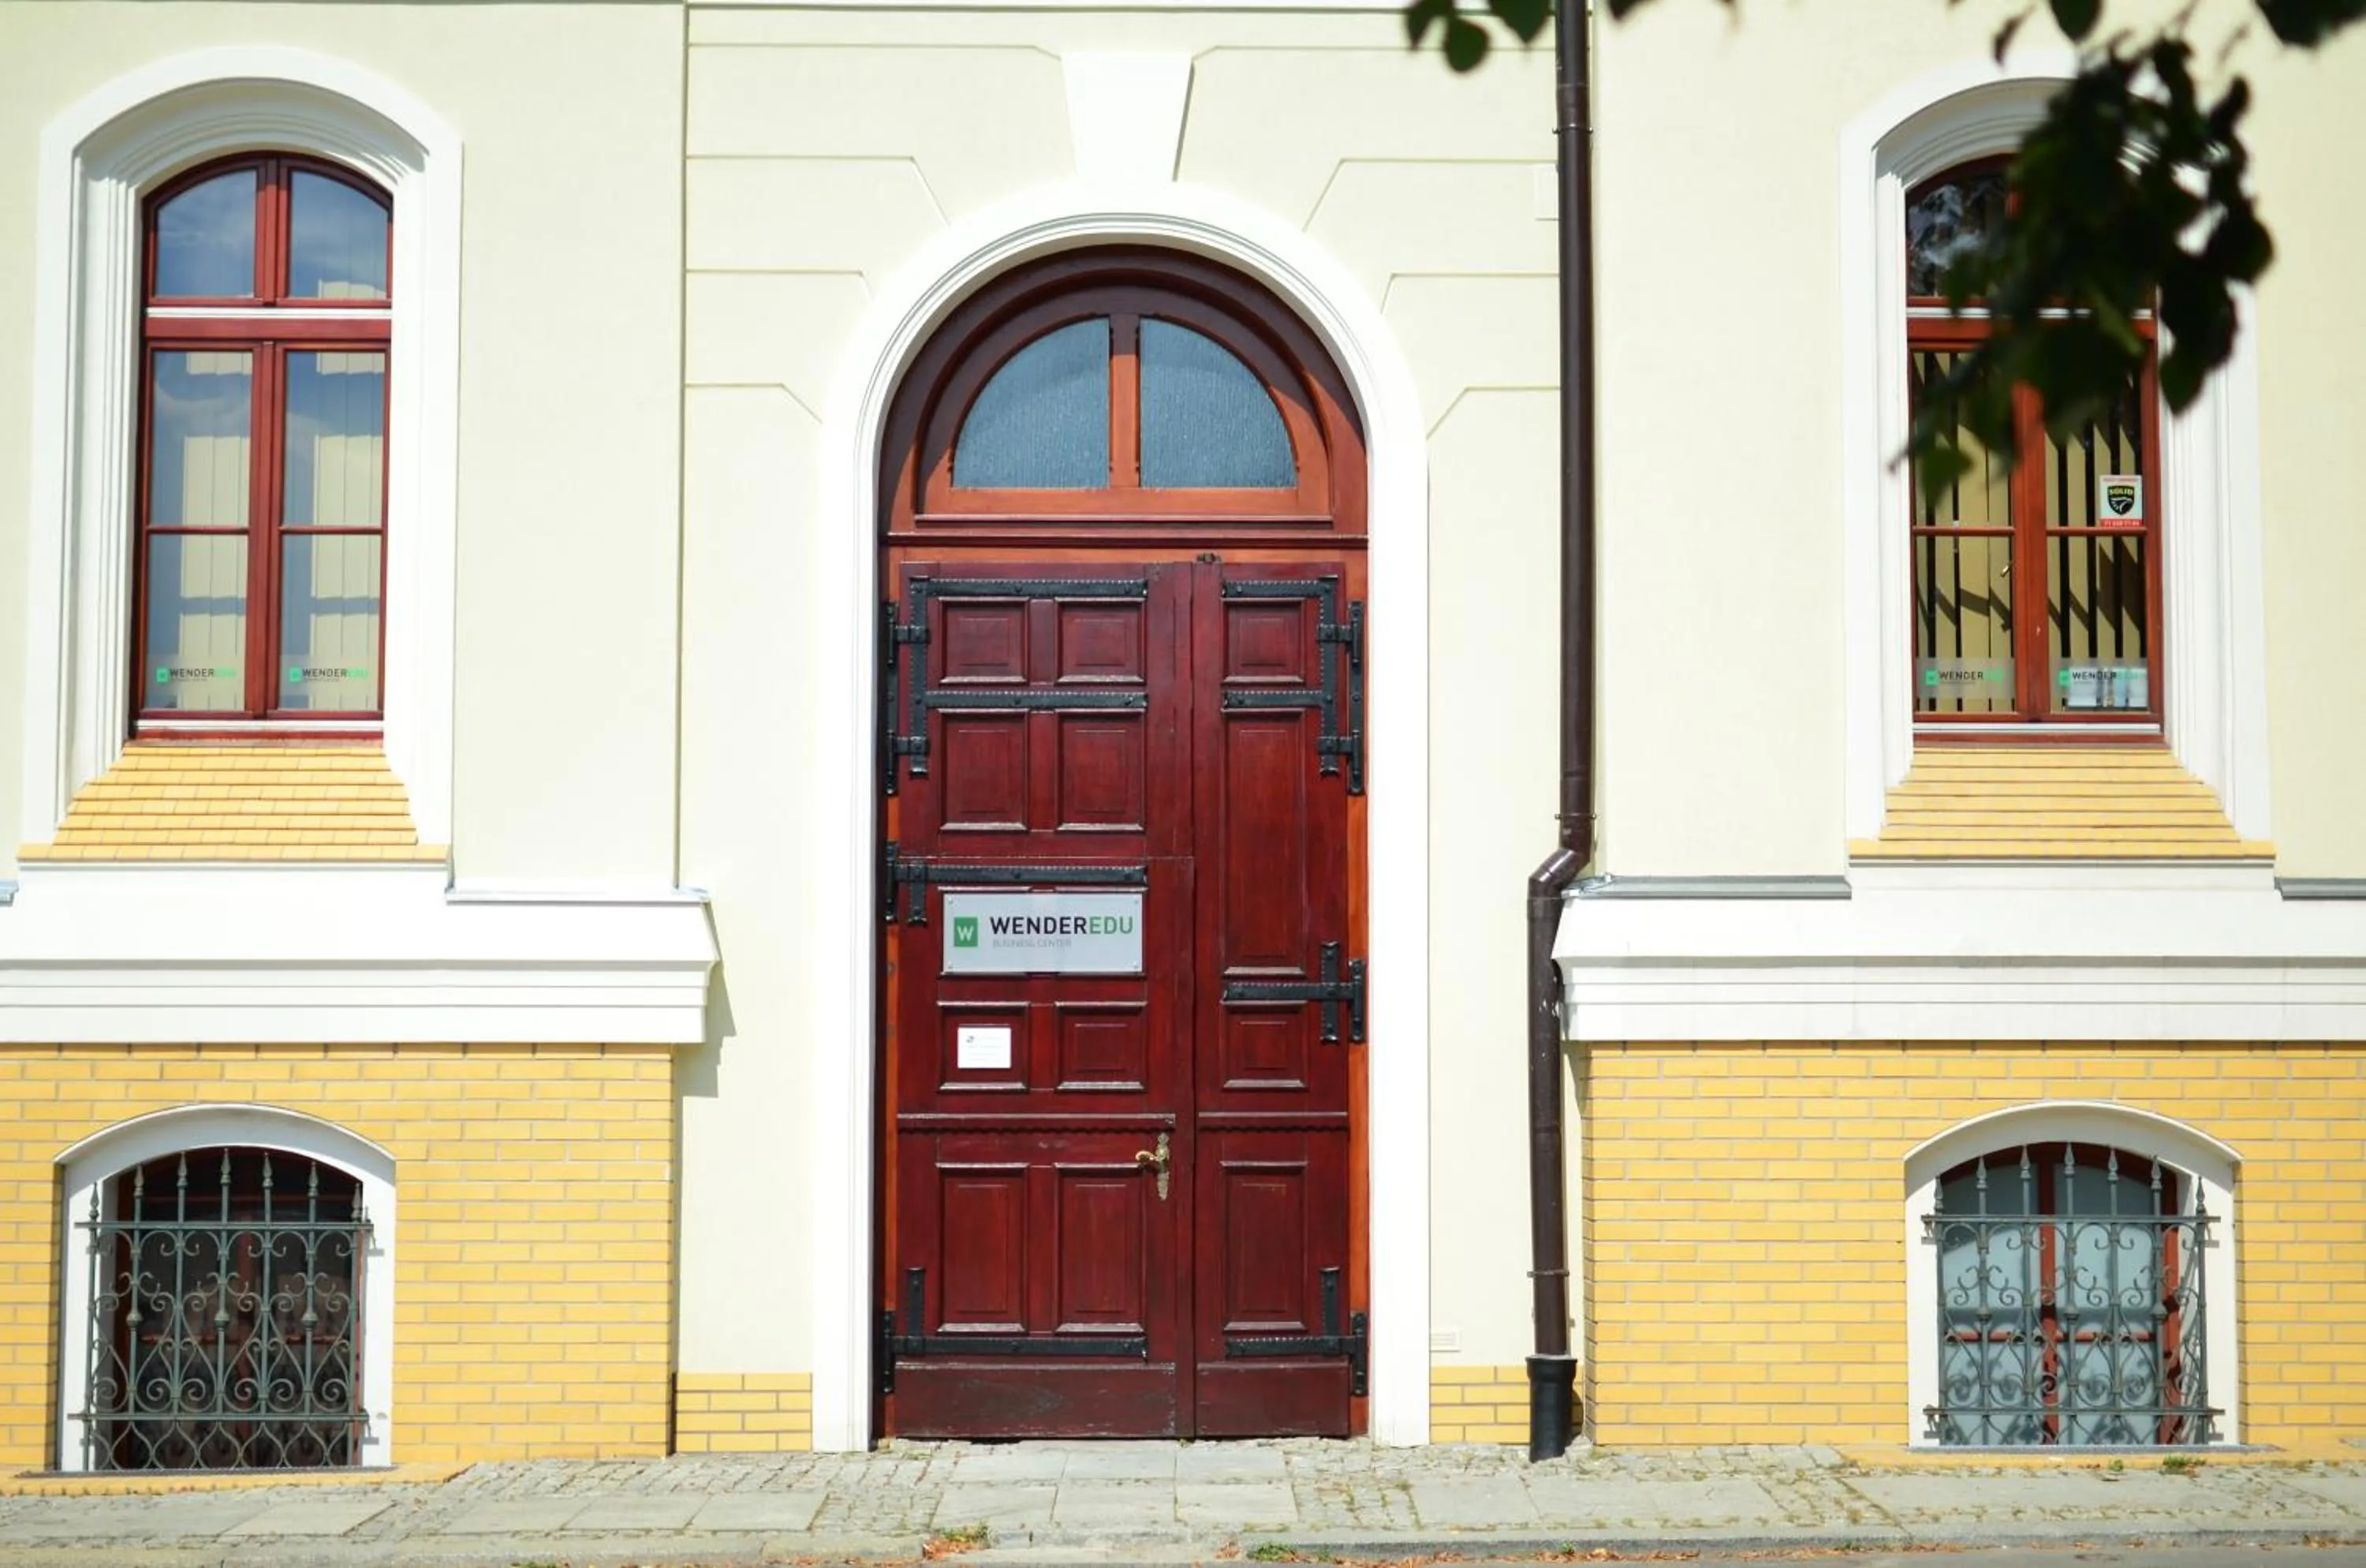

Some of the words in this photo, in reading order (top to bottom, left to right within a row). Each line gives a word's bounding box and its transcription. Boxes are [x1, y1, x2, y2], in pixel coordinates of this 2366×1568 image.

[1939, 670, 2003, 681] WENDER
[957, 925, 975, 943] W
[989, 916, 1134, 935] WENDEREDU
[1037, 939, 1073, 948] CENTER
